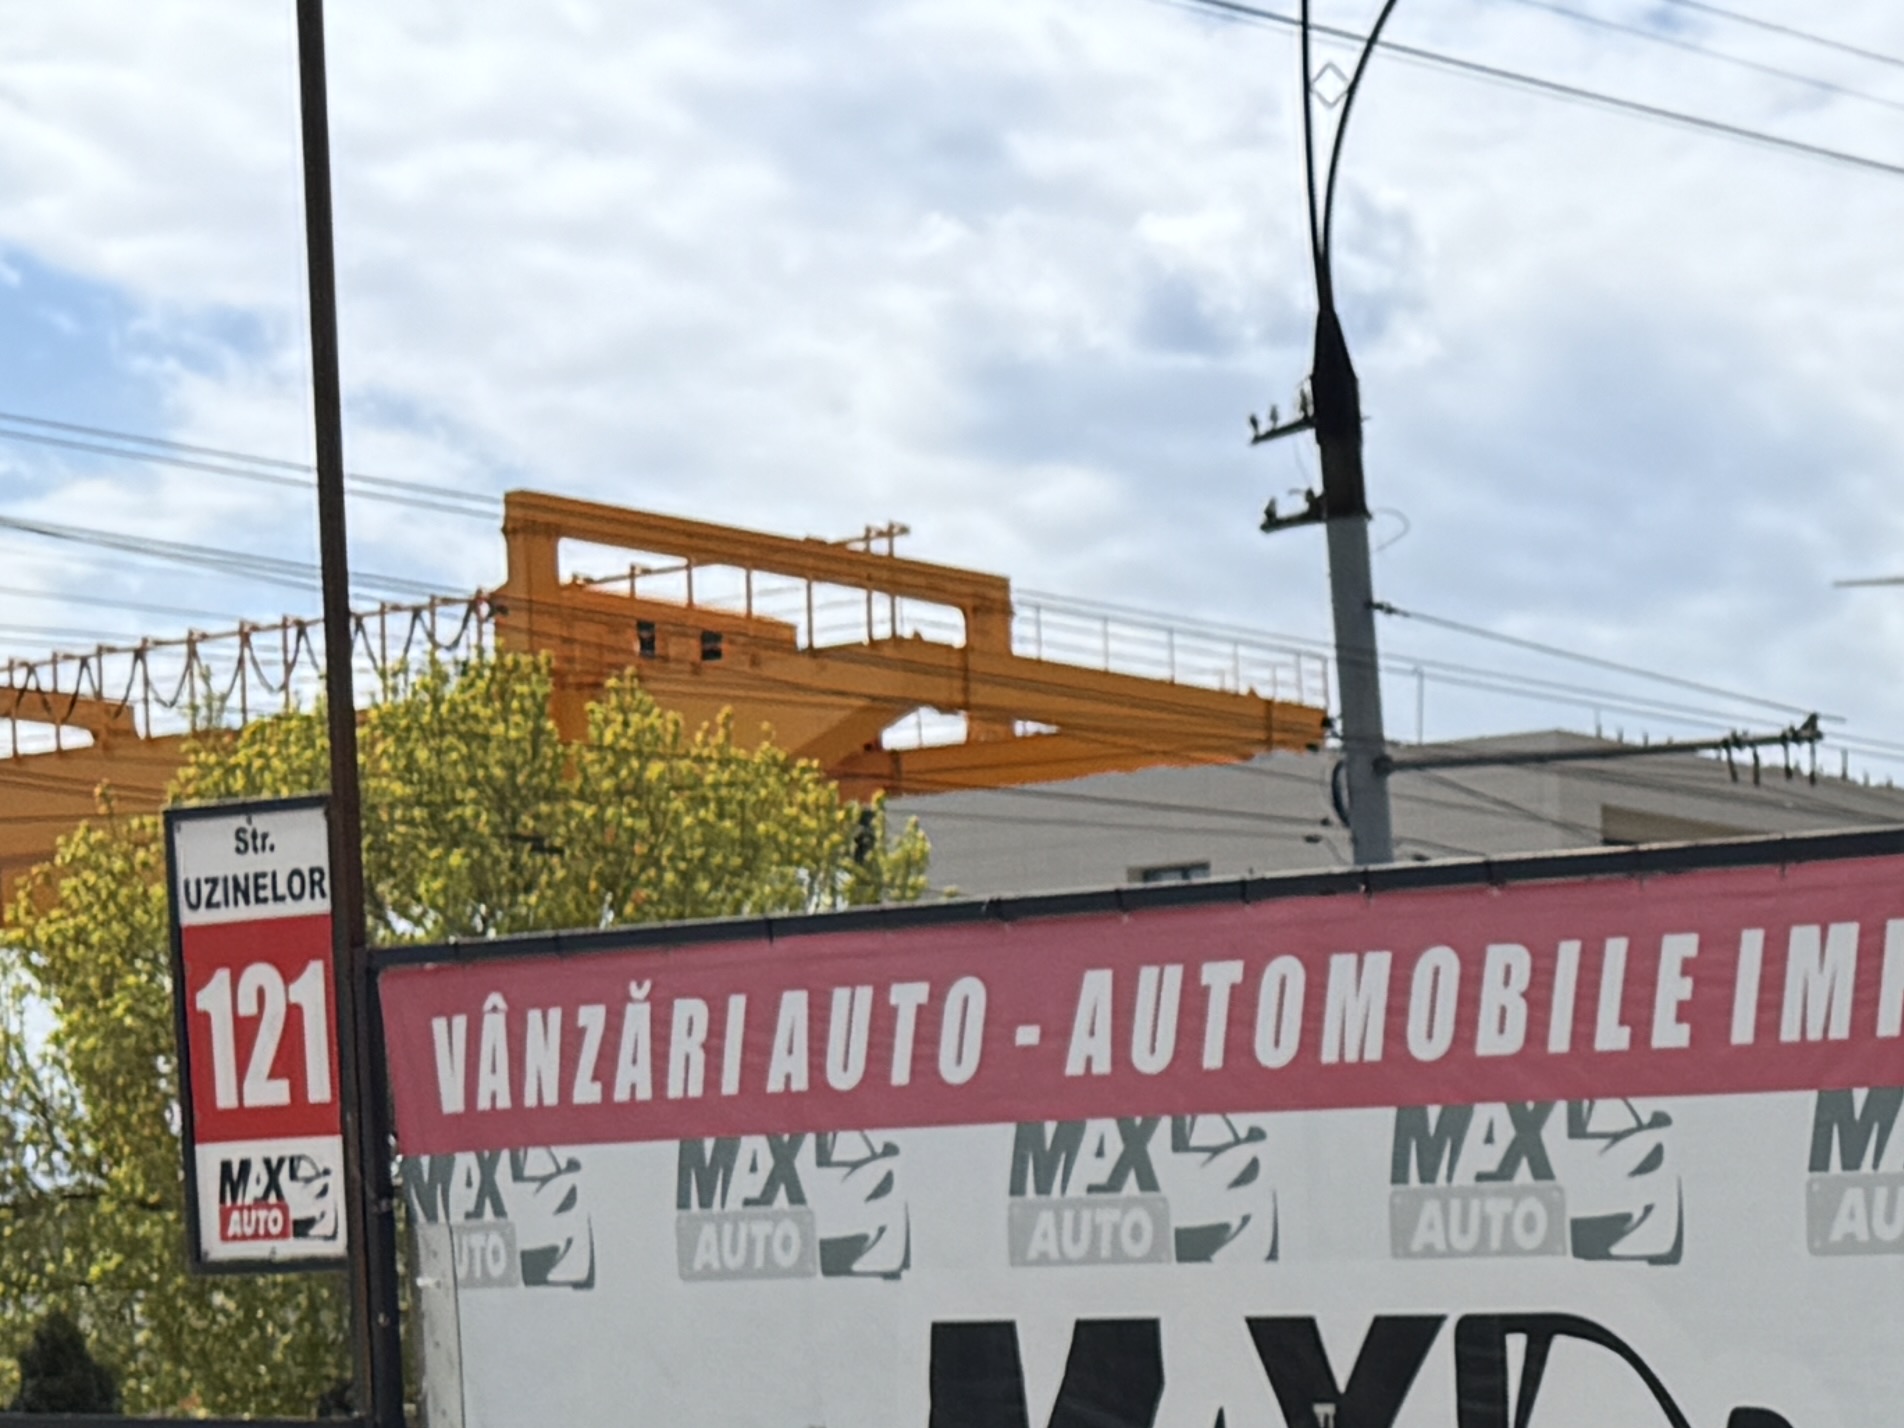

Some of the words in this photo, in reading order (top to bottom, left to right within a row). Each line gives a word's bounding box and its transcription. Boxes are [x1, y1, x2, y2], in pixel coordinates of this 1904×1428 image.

[233, 826, 275, 855] Str.
[183, 866, 327, 911] UZINELOR
[196, 959, 332, 1110] 121
[431, 980, 747, 1115] VÂNZĂRI
[766, 975, 987, 1093] AUTO
[1014, 1023, 1041, 1046] -
[1064, 931, 1700, 1078] AUTOMOBILE
[676, 1132, 808, 1210] MAX
[1009, 1115, 1164, 1198] MAX
[1390, 1101, 1556, 1186] MAX
[219, 1156, 286, 1205] MAX
[226, 1209, 284, 1238] AUTO
[693, 1218, 799, 1271] AUTO
[1026, 1207, 1154, 1262] AUTO
[1410, 1194, 1549, 1252] AUTO
[456, 1231, 507, 1279] UTO
